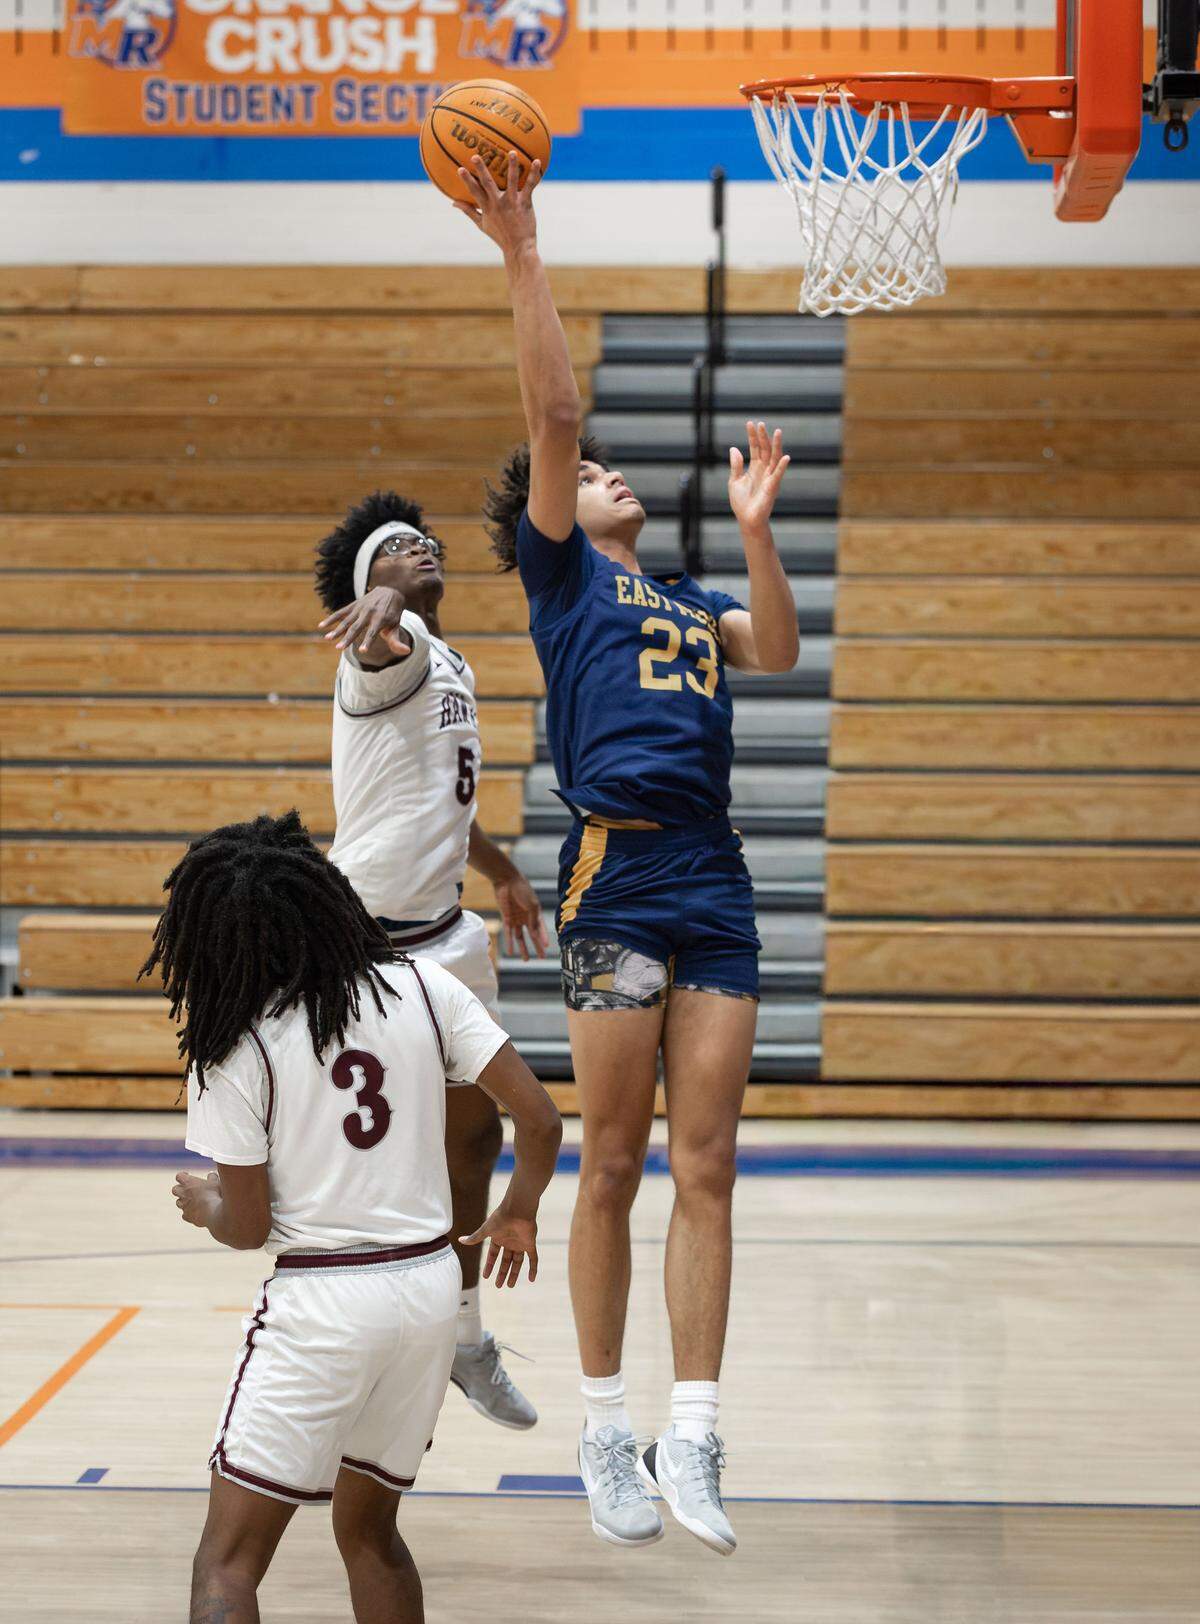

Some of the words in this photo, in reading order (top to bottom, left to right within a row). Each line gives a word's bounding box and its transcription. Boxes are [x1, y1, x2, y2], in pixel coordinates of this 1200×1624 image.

[205, 16, 437, 74] CRUSH
[144, 78, 320, 124] STUDENT
[638, 616, 719, 699] 23
[455, 745, 475, 806] 5
[330, 1048, 392, 1151] 3
